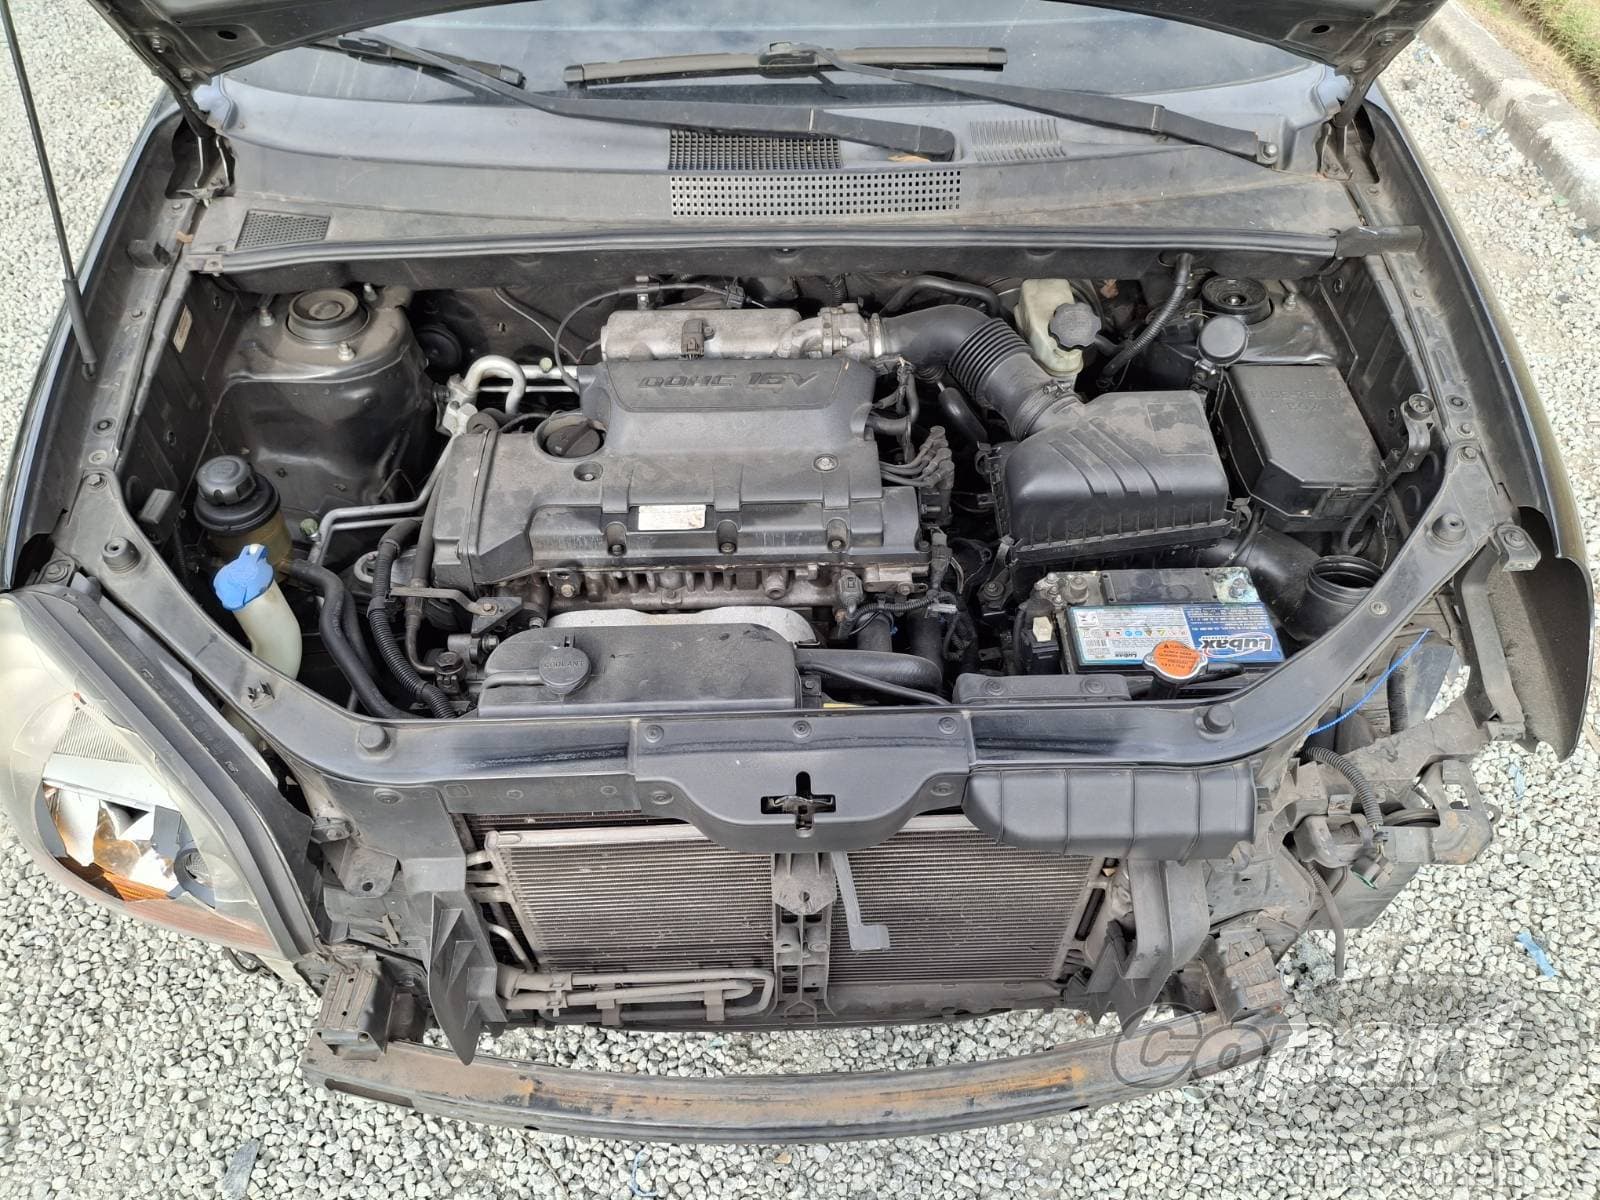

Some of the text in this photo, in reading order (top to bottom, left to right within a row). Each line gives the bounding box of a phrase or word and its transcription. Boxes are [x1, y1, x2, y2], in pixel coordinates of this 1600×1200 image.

[639, 372, 818, 392] DOHC 16V
[1201, 637, 1273, 652] Lubax
